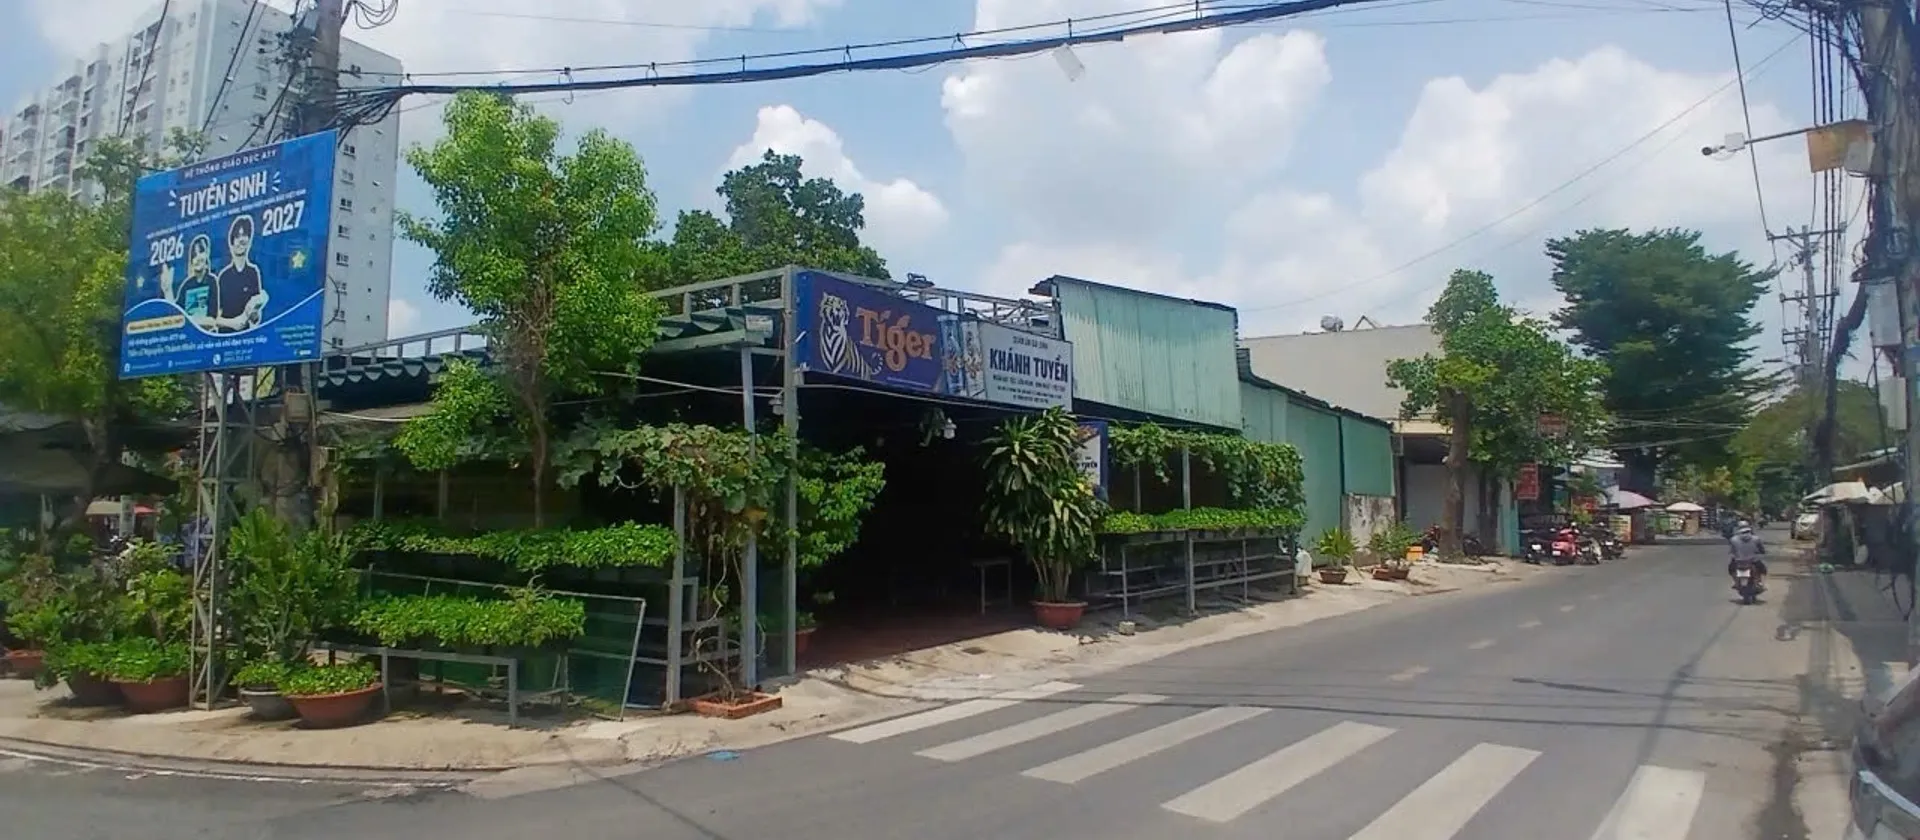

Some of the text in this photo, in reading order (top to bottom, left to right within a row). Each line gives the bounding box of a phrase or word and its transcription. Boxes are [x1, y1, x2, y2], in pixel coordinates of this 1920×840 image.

[180, 178, 227, 218] TUYỂN
[229, 170, 267, 203] SINH
[262, 200, 306, 237] 2027
[149, 233, 185, 267] 2026
[855, 307, 937, 372] Tiger
[989, 347, 1030, 375] KHÁNH
